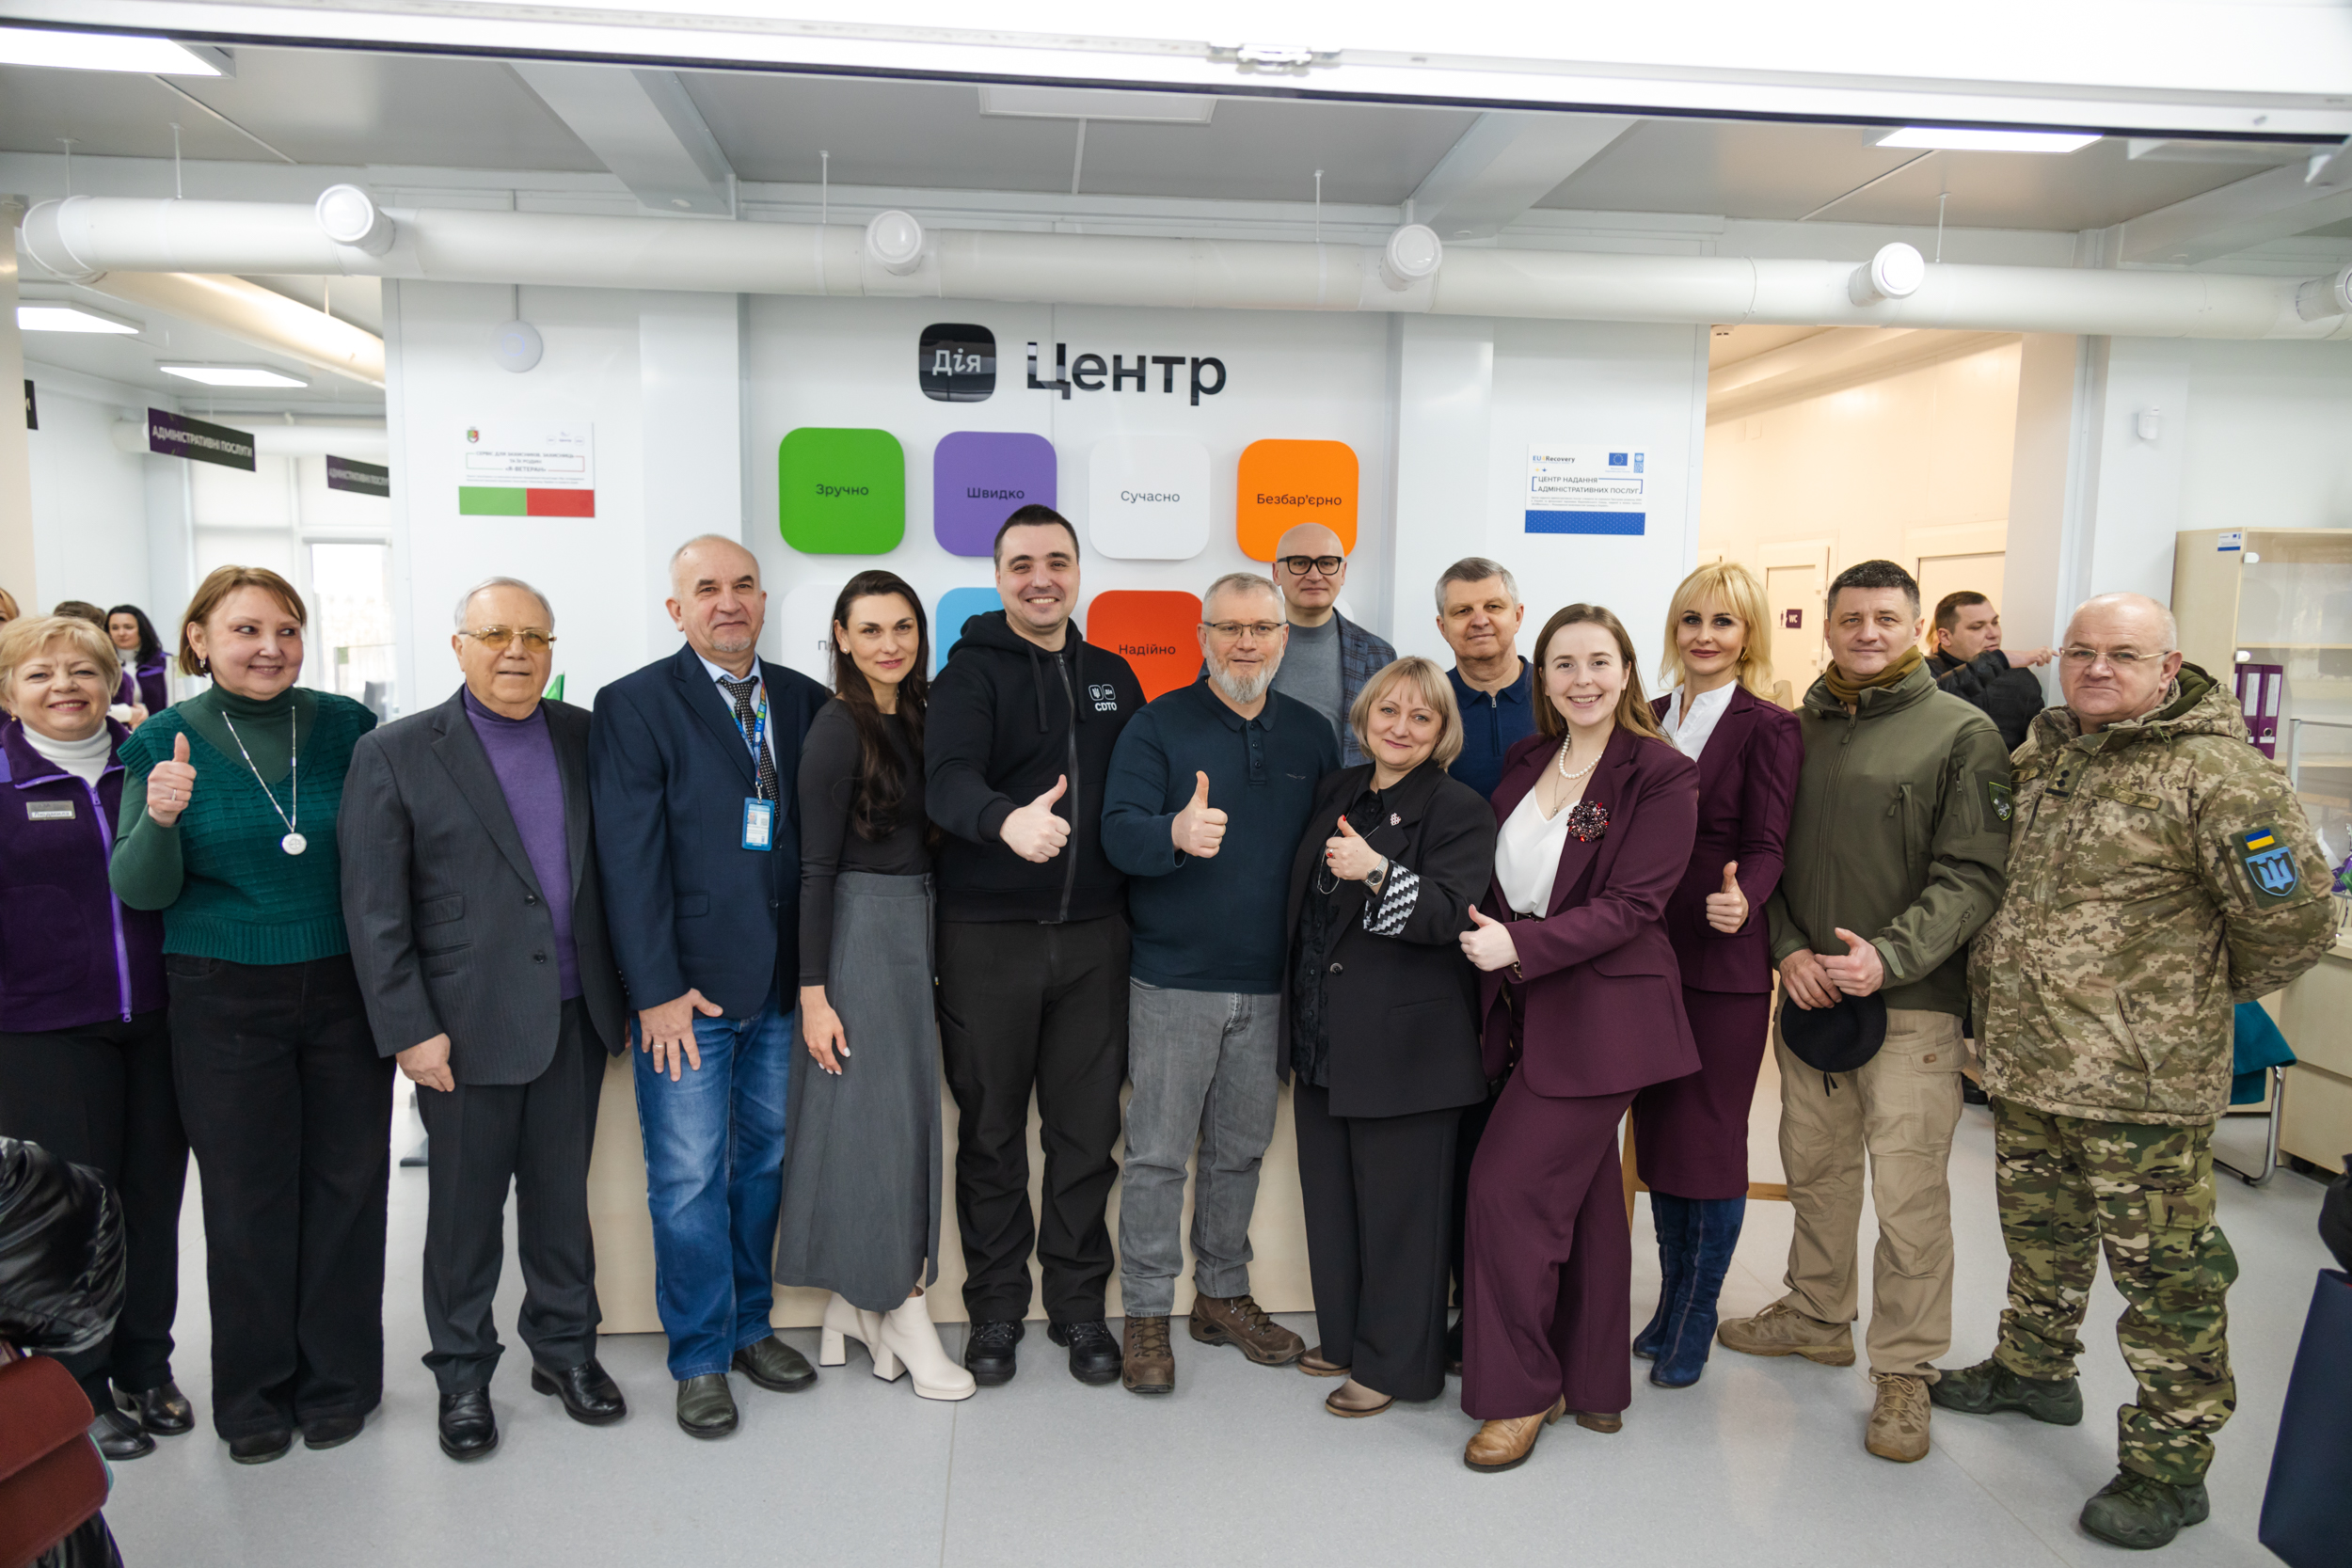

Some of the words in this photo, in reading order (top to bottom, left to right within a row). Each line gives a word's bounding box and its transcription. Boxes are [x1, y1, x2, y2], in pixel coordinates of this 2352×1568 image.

[932, 348, 981, 376] Дія
[1027, 341, 1227, 406] Центр
[152, 424, 220, 451] АДМІНІСТРАТИВНІ
[221, 439, 253, 457] ПОСЛУГИ
[816, 483, 869, 499] Зручно
[966, 487, 1025, 501] Швидко
[1538, 485, 1609, 494] АДМІНІСТРАТИВНИХ
[1120, 490, 1181, 505] Сучасно
[1788, 614, 1798, 624] WC
[1119, 642, 1176, 657] Надійно
[1094, 702, 1118, 712] CDTO
